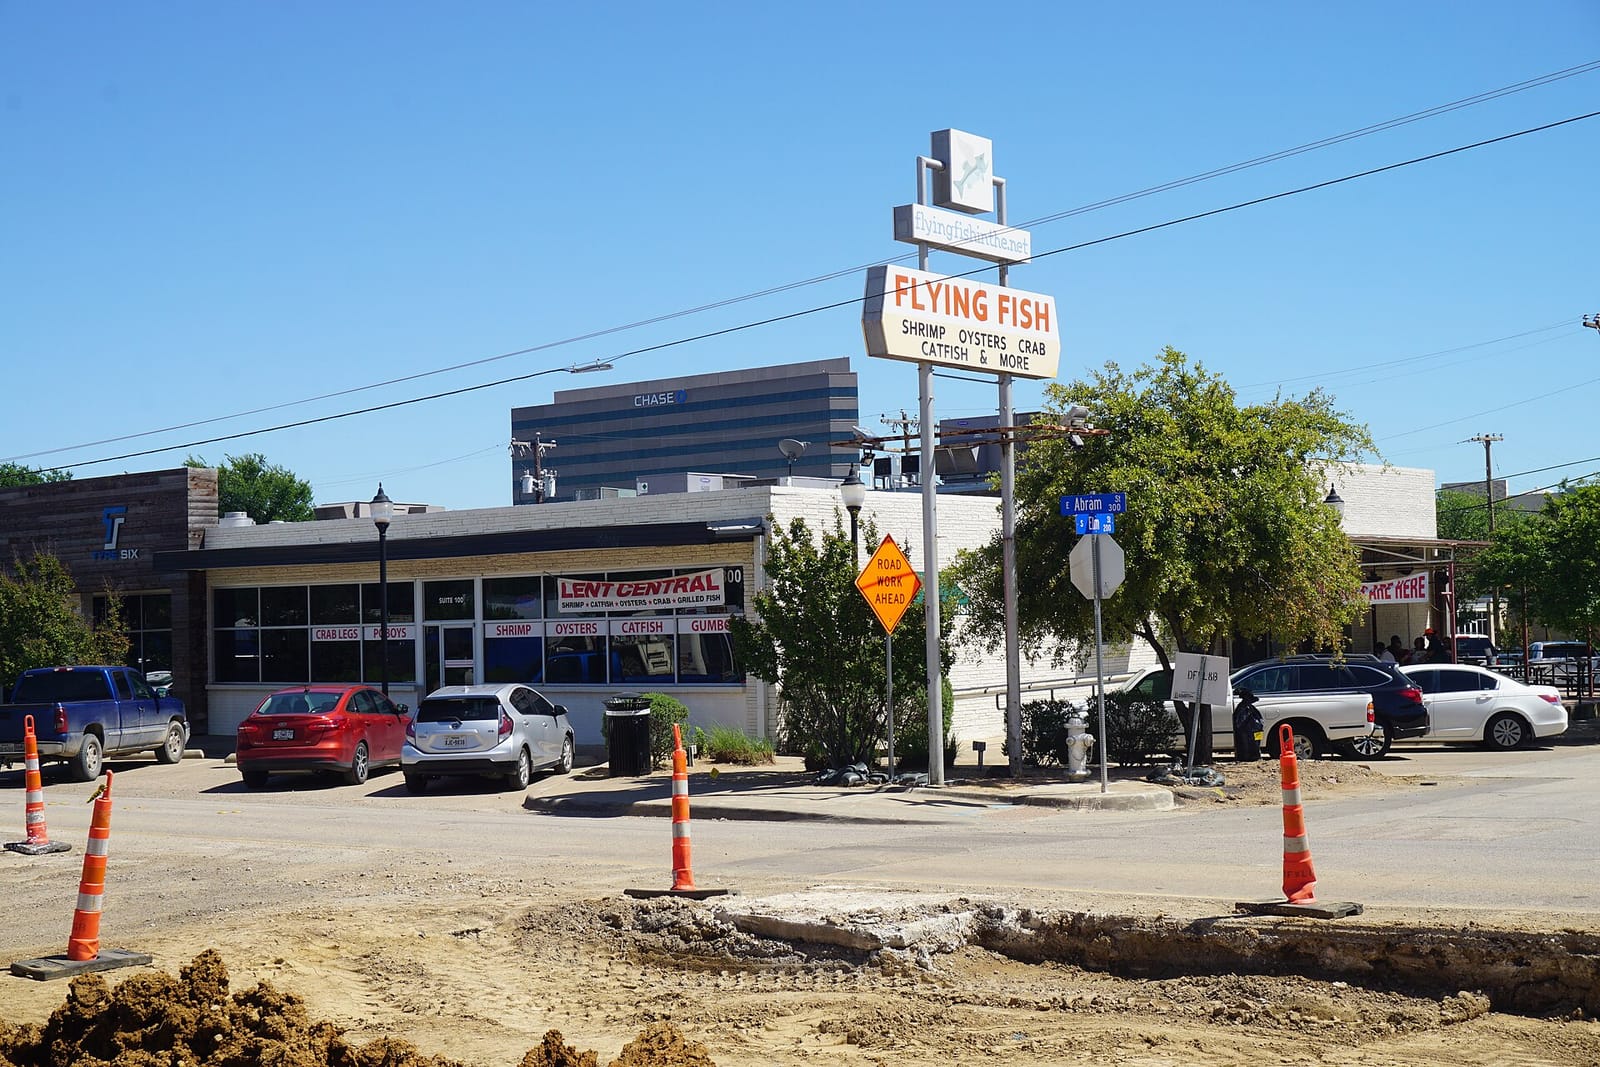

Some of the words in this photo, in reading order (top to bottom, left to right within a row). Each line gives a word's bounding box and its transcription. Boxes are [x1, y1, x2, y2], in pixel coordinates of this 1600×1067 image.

[915, 210, 1028, 255] flyingfishinthe.net
[895, 274, 988, 322] FLYING
[998, 293, 1050, 332] FISH
[902, 319, 946, 340] SHRIMP
[959, 329, 1007, 351] OYSTERS
[1018, 339, 1046, 356] CRAB
[921, 341, 969, 361] CATFISH
[979, 349, 988, 365] &
[1000, 353, 1029, 370] MORE
[634, 392, 674, 407] CHASE
[1066, 501, 1070, 509] E
[1074, 497, 1102, 511] Abram
[1108, 503, 1121, 512] 300
[1088, 516, 1100, 530] Elm
[120, 549, 138, 559] SIX
[877, 558, 902, 570] ROAD
[561, 581, 615, 598] LENT
[616, 573, 720, 598] CENTRAL
[877, 576, 902, 588] WORK
[1395, 576, 1426, 599] HERE
[561, 601, 585, 609] SHRIMP
[589, 600, 614, 608] CATFISH
[619, 598, 647, 607] OYSTERS
[652, 597, 672, 605] CRAB
[677, 595, 705, 604] GRILLED
[706, 593, 721, 602] FISH
[875, 593, 905, 605] AHEAD
[316, 628, 337, 640] CRAB
[338, 627, 358, 640] LEGS
[496, 624, 532, 636] SHRIMP
[555, 623, 597, 634] OYSTERS
[621, 621, 663, 633] CATFISH
